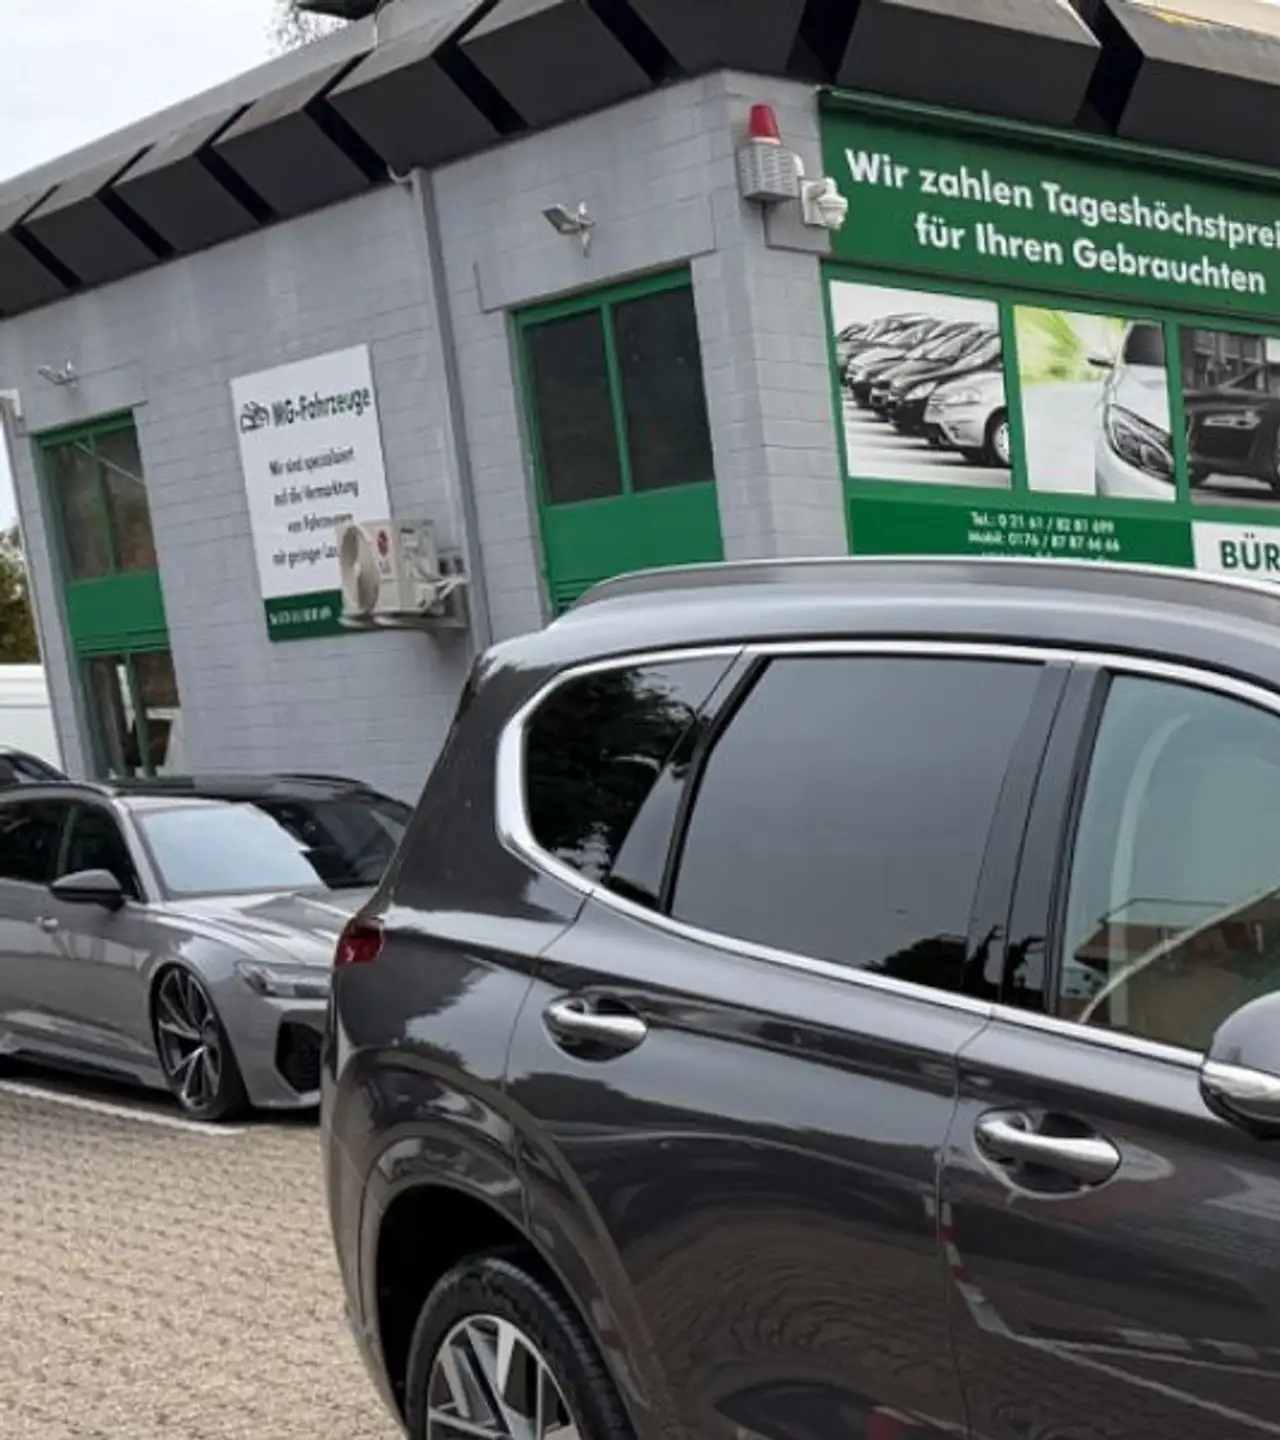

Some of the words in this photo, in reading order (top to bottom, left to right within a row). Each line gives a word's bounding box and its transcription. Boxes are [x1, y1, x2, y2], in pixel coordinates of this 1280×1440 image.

[845, 147, 909, 190] Wir
[918, 164, 1034, 210] zahlen
[914, 211, 965, 250] für
[975, 222, 1063, 265] Ihren
[1072, 236, 1267, 295] Gebrauchten
[271, 387, 371, 428] MG-Fahrzeuge
